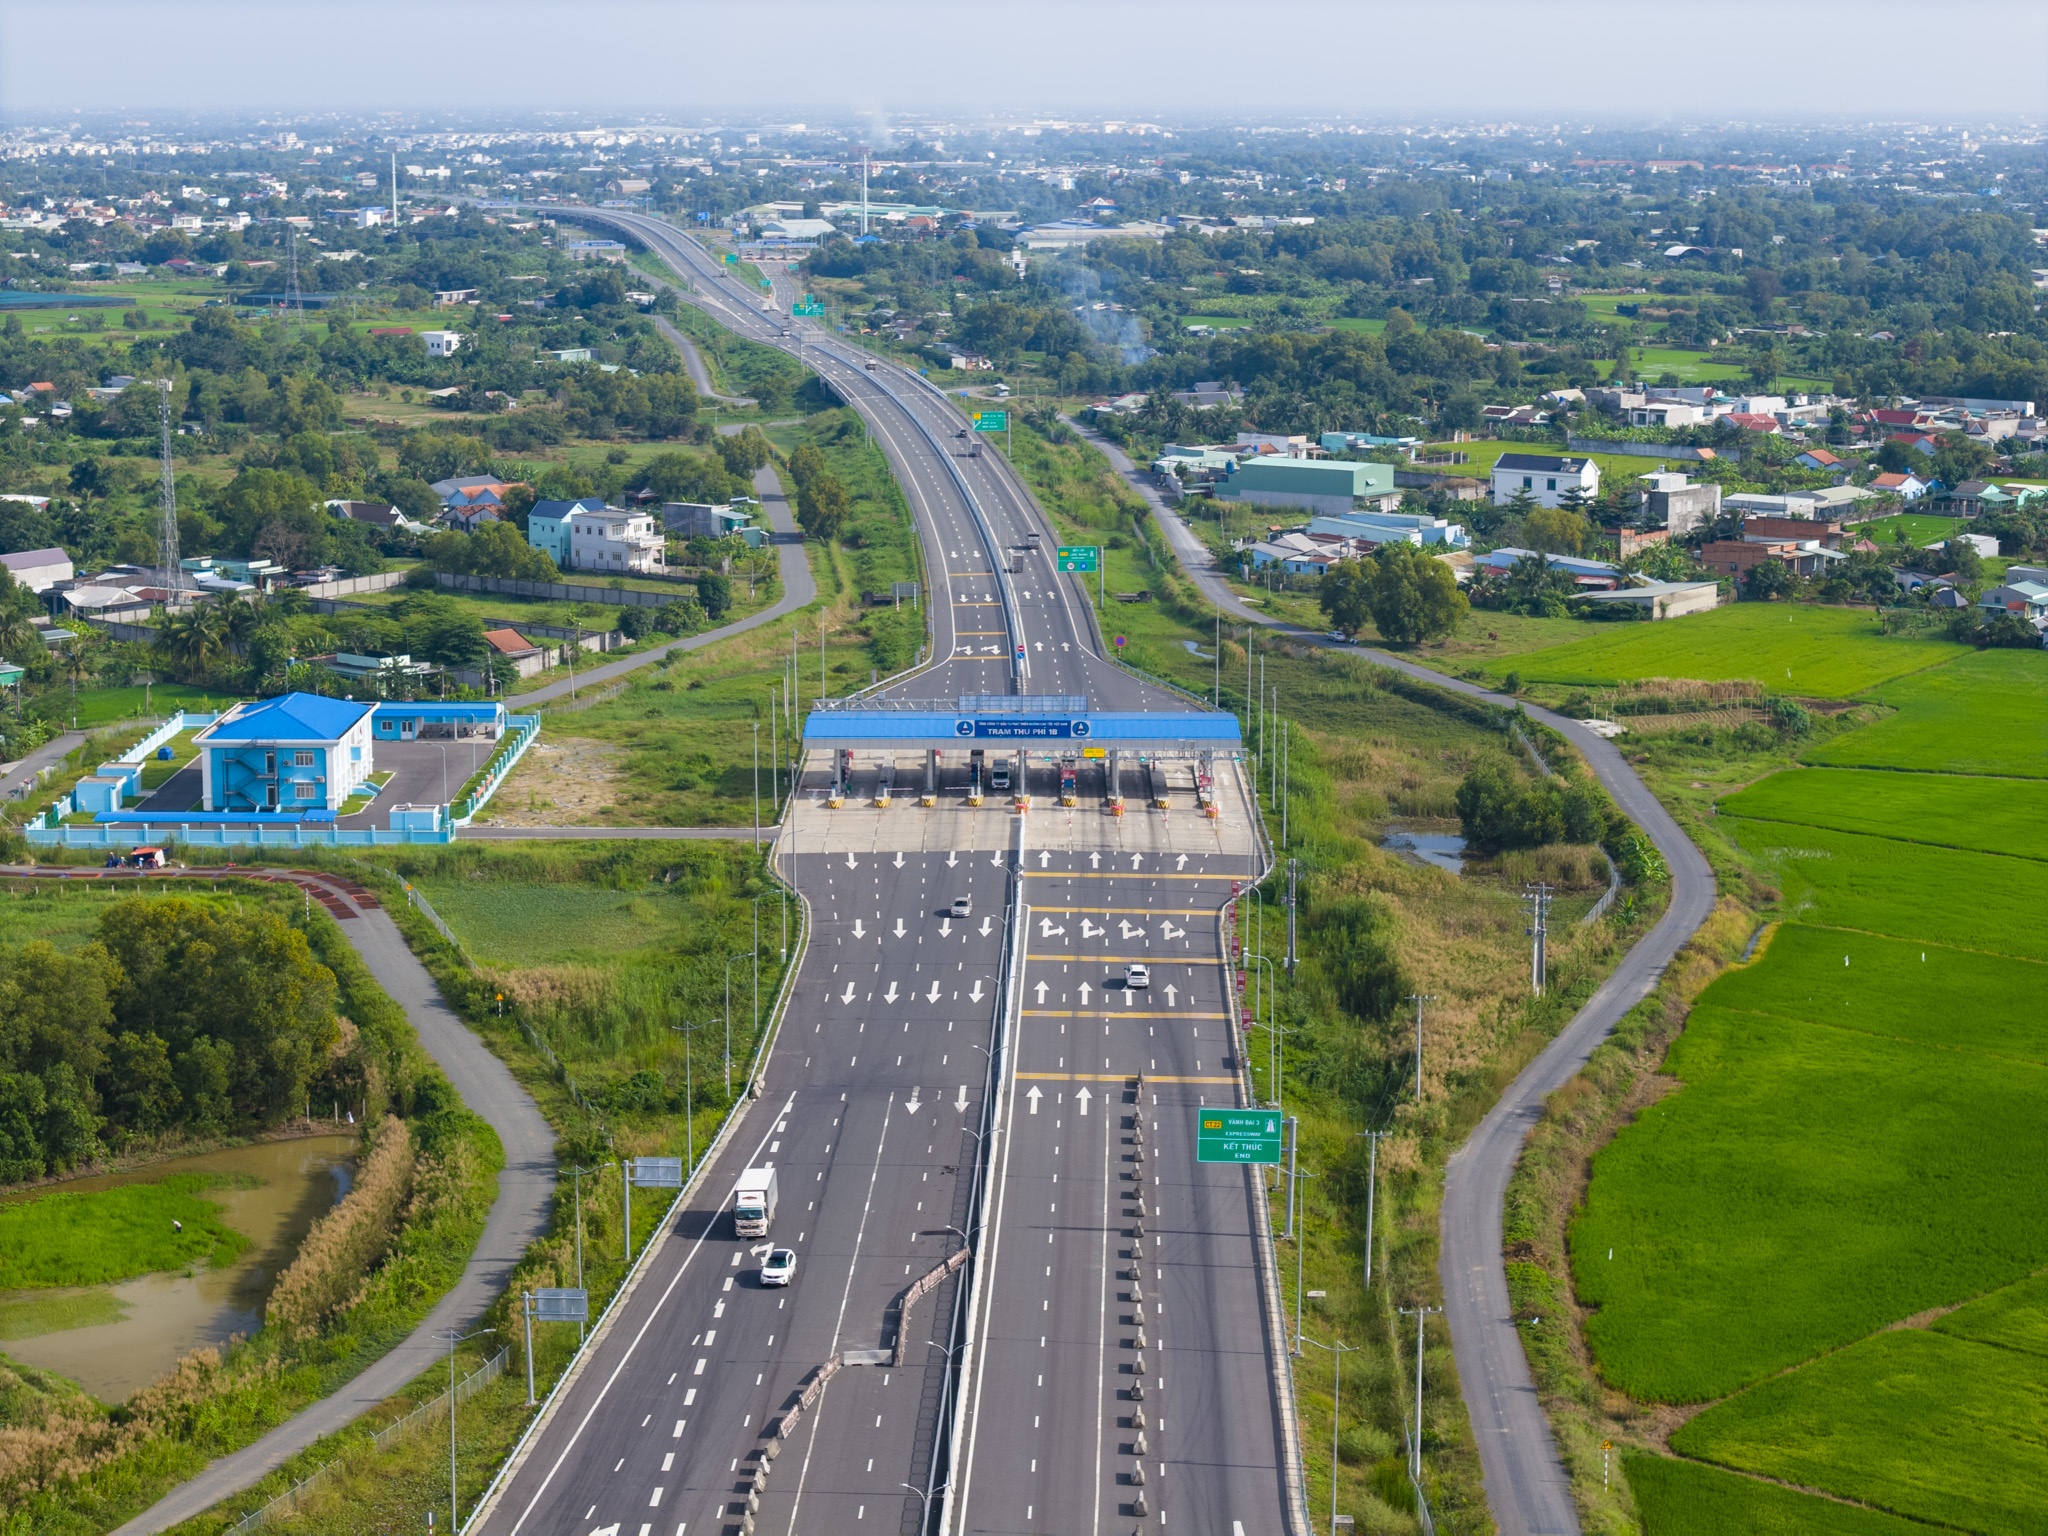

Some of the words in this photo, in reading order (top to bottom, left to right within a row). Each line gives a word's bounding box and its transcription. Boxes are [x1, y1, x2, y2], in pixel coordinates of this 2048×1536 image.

[987, 728, 1011, 737] TRẠM
[1032, 727, 1046, 735] PHÍ
[1223, 1141, 1240, 1150] KẾT
[1241, 1141, 1263, 1151] THÚC
